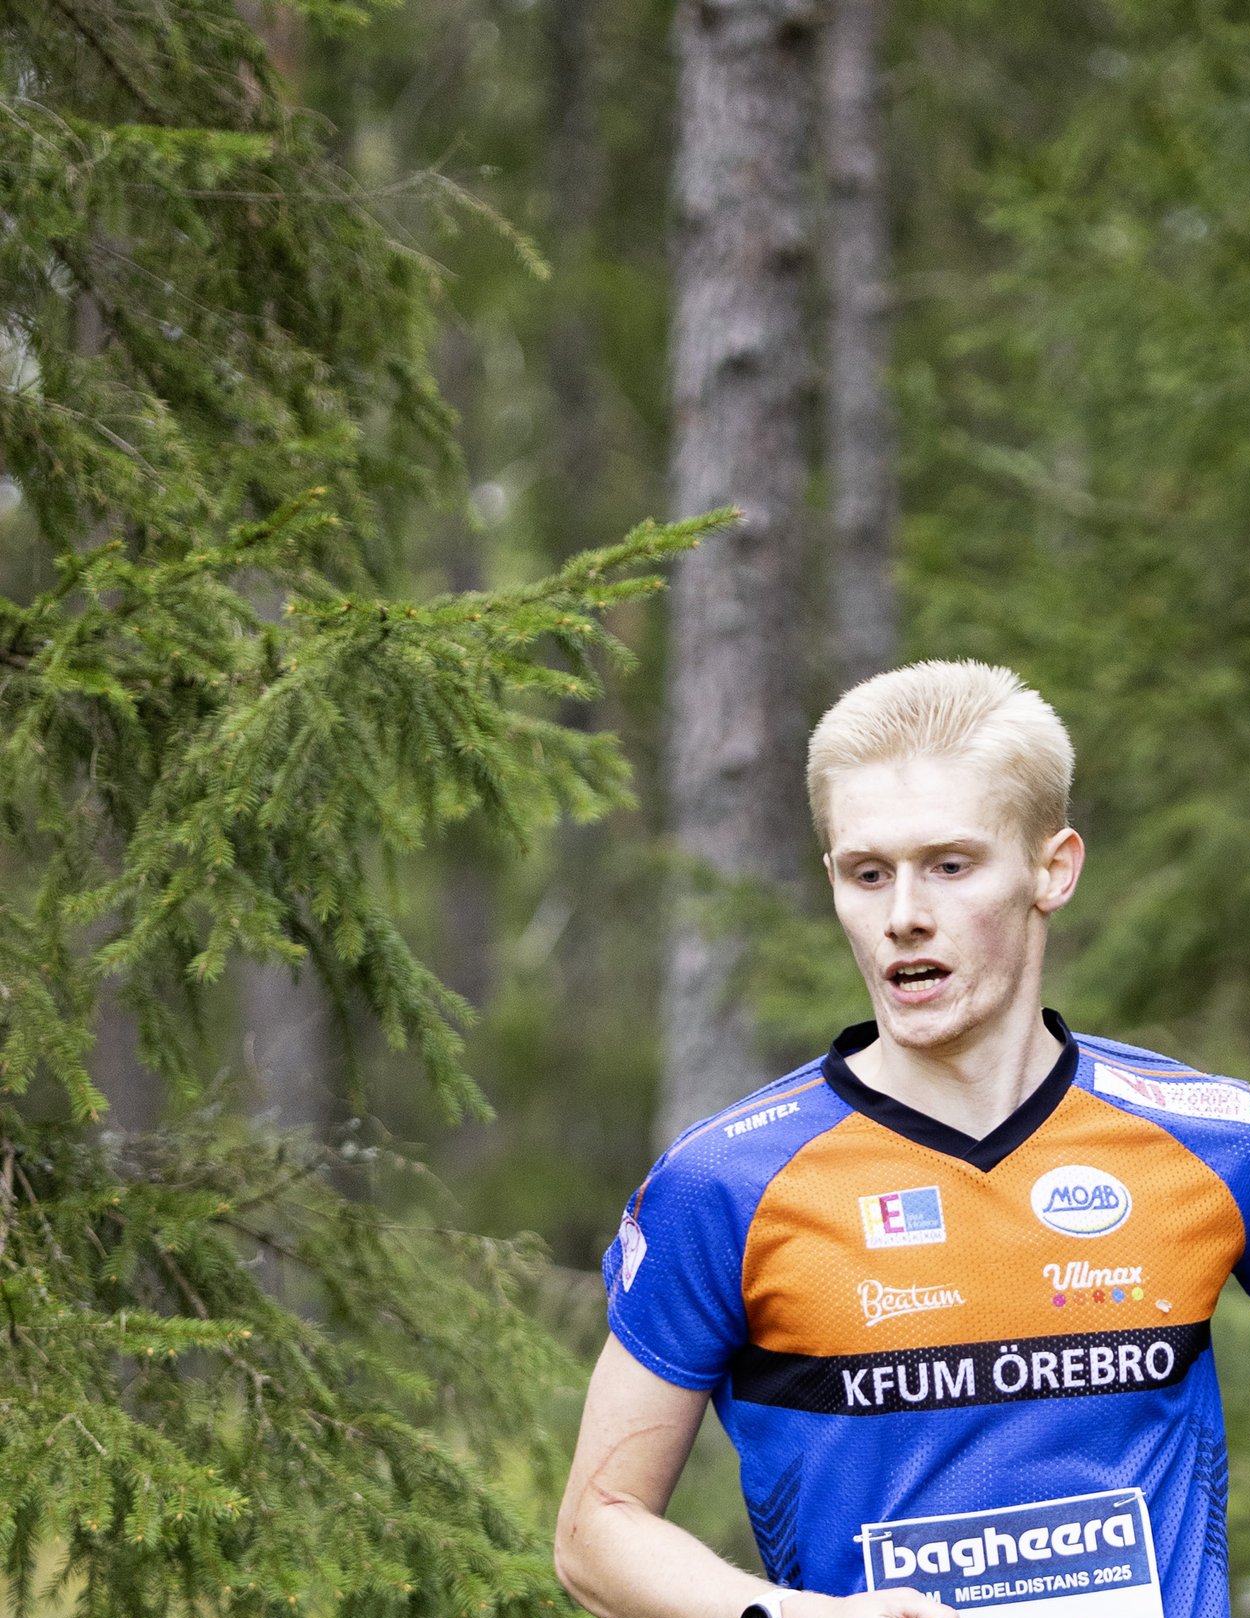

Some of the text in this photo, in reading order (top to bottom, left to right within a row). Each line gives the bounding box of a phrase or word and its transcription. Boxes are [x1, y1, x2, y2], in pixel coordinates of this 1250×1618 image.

[723, 1102, 800, 1138] TRIMTEX
[1042, 1185, 1119, 1212] MOAB
[1043, 1260, 1142, 1291] Ullmax
[857, 1279, 967, 1327] Beatum
[842, 1341, 1175, 1407] KFUM ÖREBRO
[880, 1512, 1137, 1580] bagheera
[955, 1571, 1090, 1603] MEDELDISTANS
[1093, 1564, 1133, 1585] 2025
